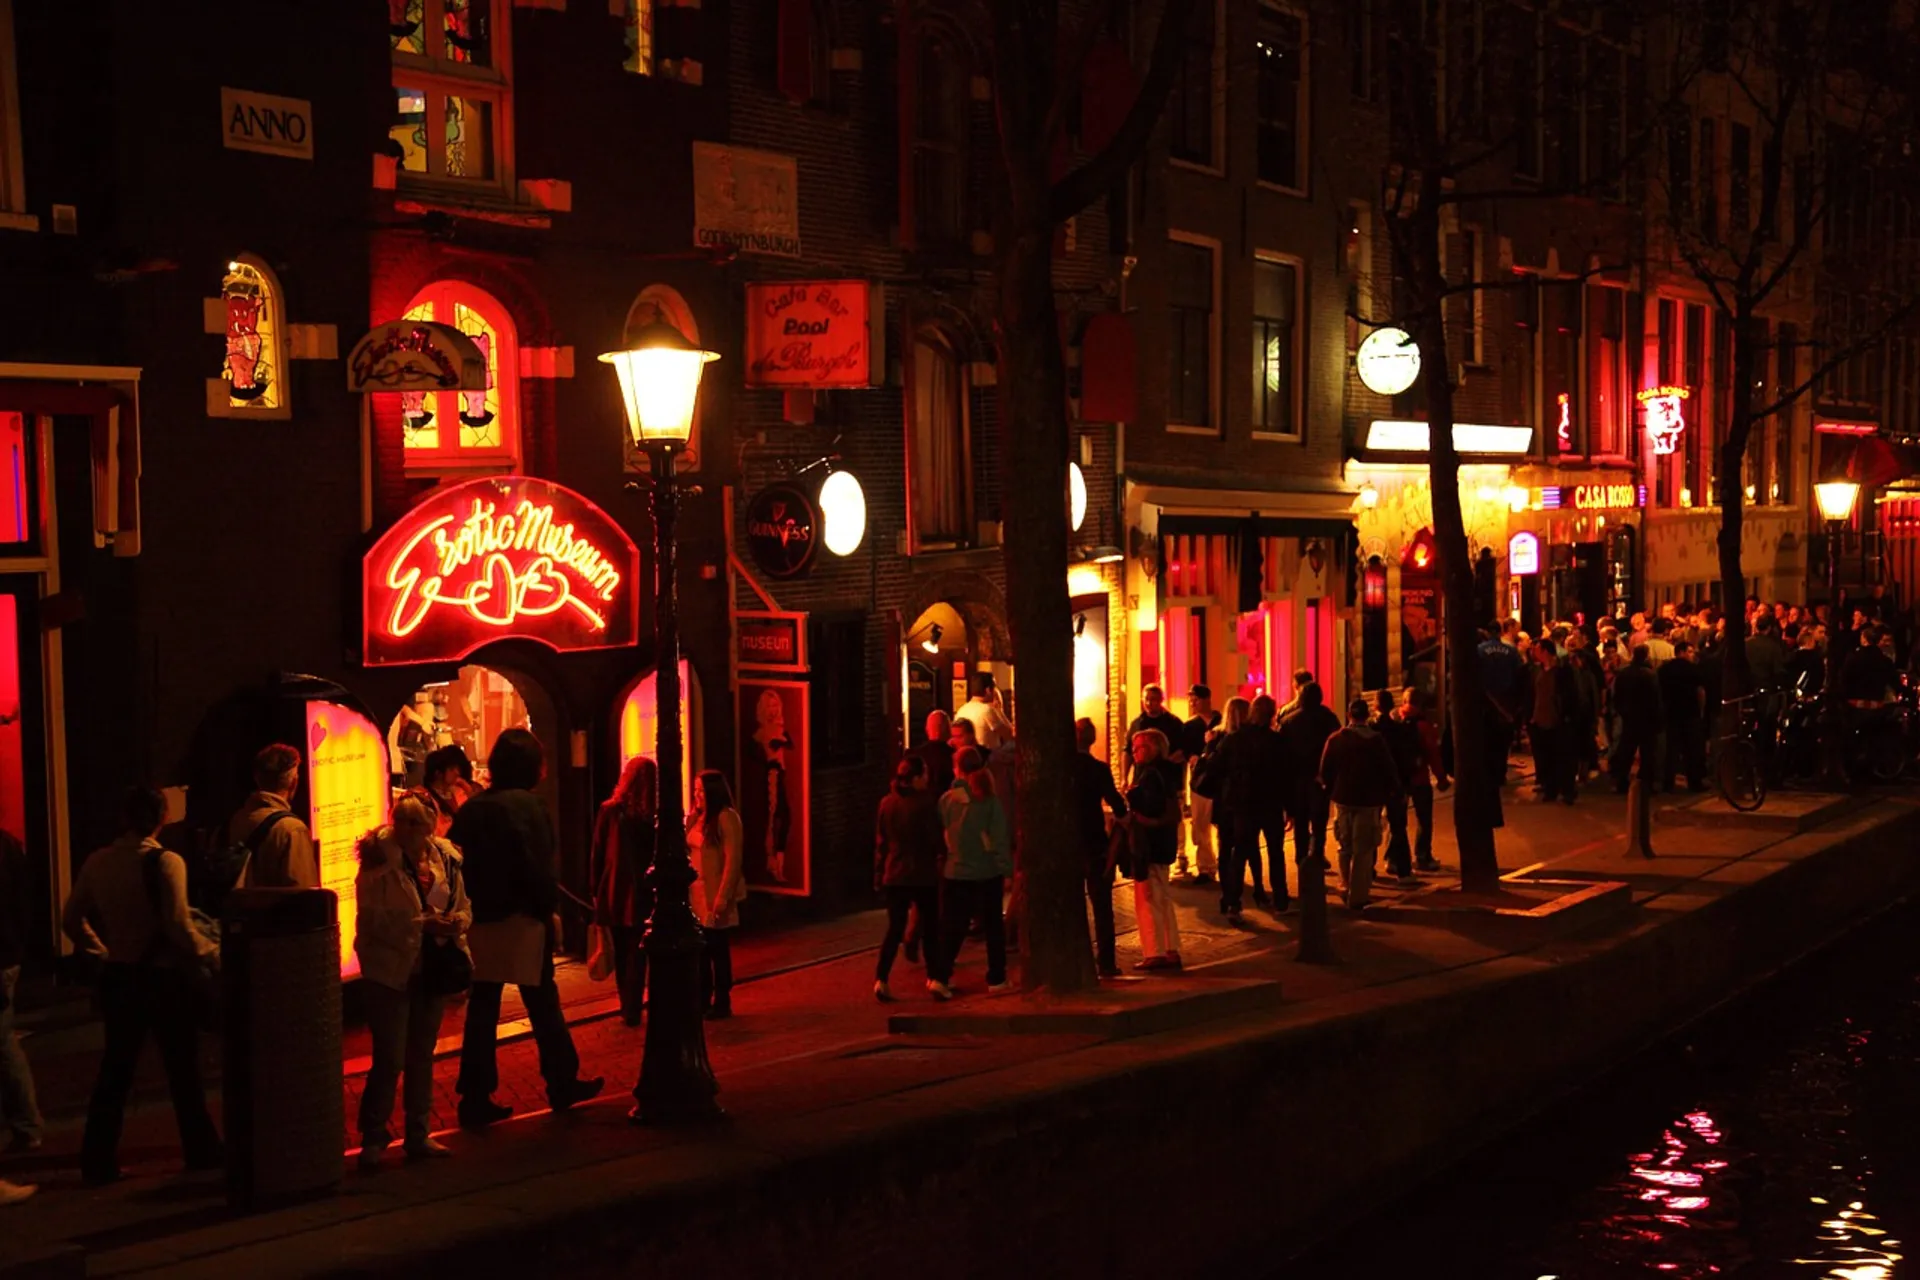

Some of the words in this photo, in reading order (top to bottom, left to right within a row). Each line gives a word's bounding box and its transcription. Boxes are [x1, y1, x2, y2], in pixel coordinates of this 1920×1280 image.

[229, 103, 306, 144] ANNO
[783, 318, 830, 336] Pool
[1575, 485, 1606, 509] CASA
[1607, 484, 1635, 508] ROSSO
[748, 520, 809, 542] GUINNESS
[386, 497, 517, 637] Erotic
[516, 500, 621, 602] Museum
[741, 635, 790, 651] MUSEUM
